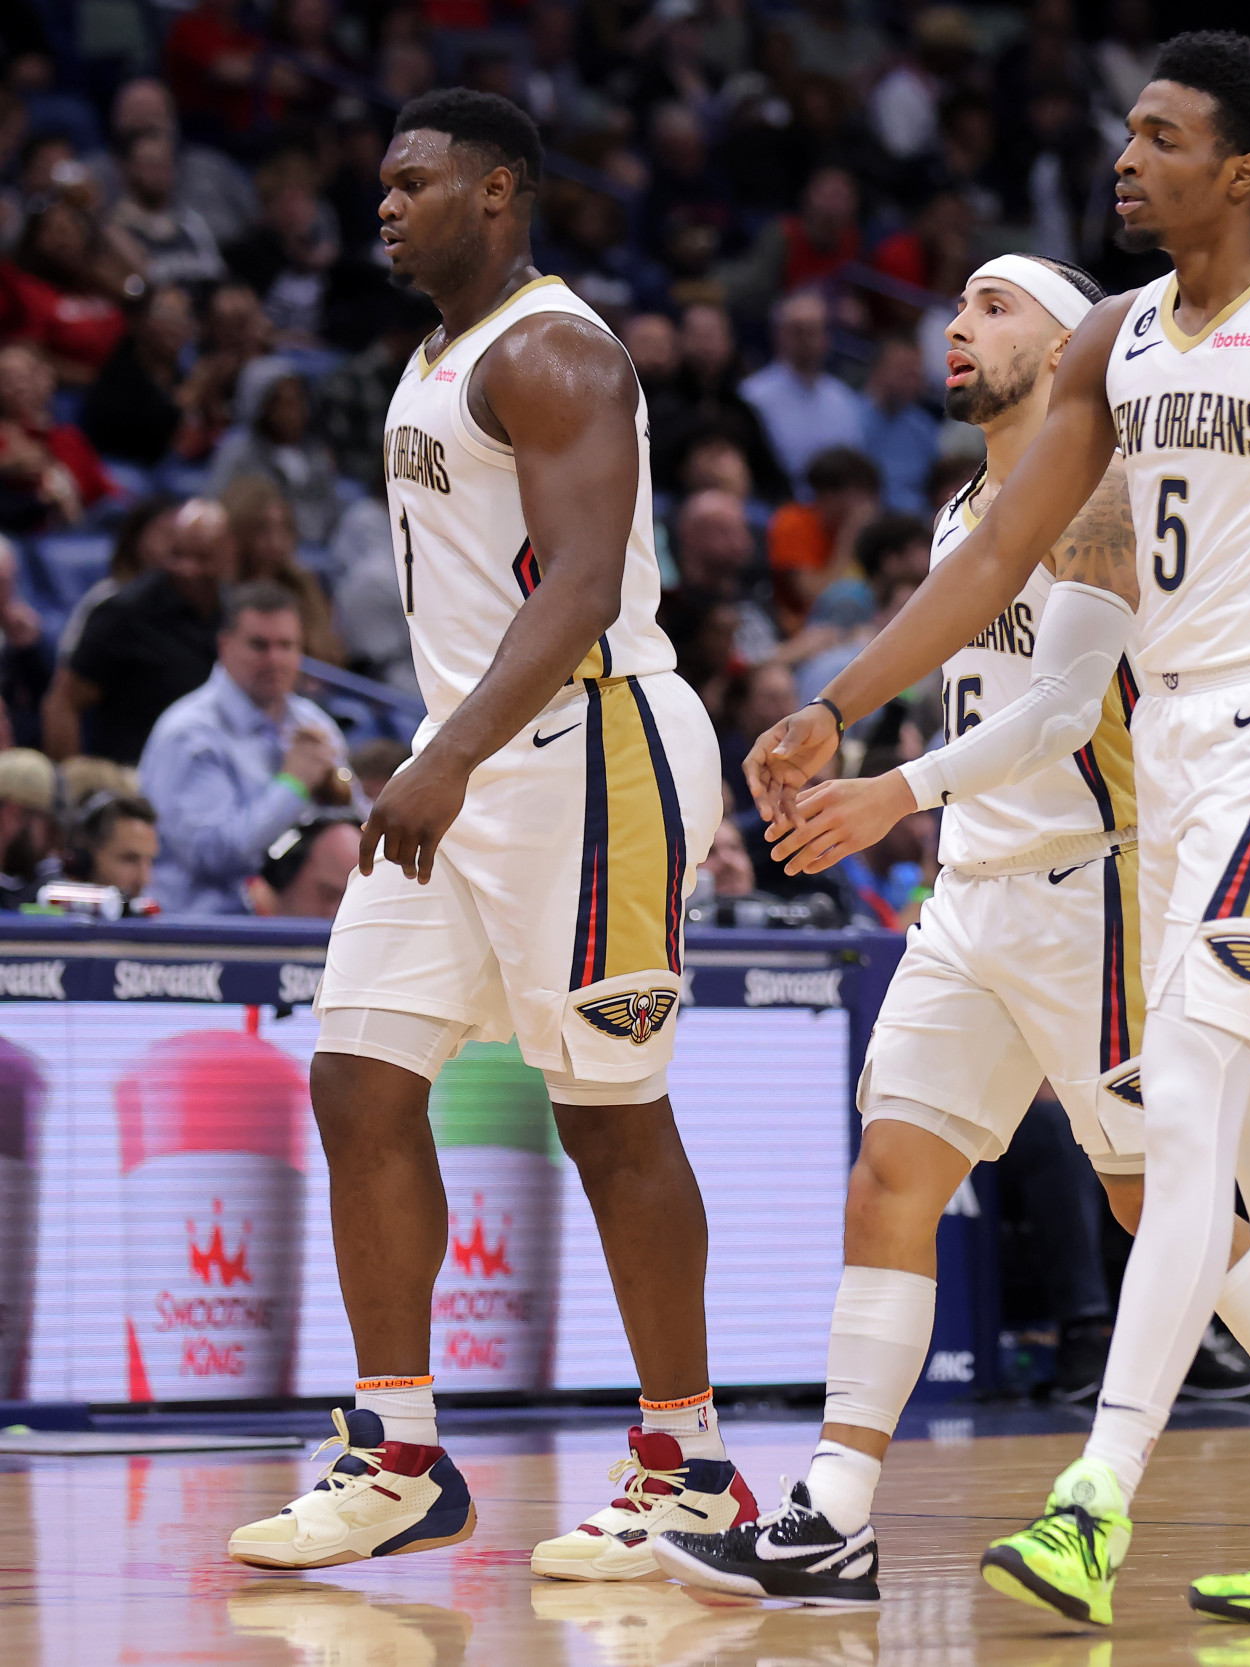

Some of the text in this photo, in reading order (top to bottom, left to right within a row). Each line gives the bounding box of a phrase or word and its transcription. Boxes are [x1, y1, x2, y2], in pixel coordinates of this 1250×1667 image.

[1136, 307, 1155, 336] 6
[393, 425, 451, 496] ORLEANS
[1113, 395, 1152, 460] EW
[399, 503, 415, 617] 1
[1152, 475, 1190, 596] 5
